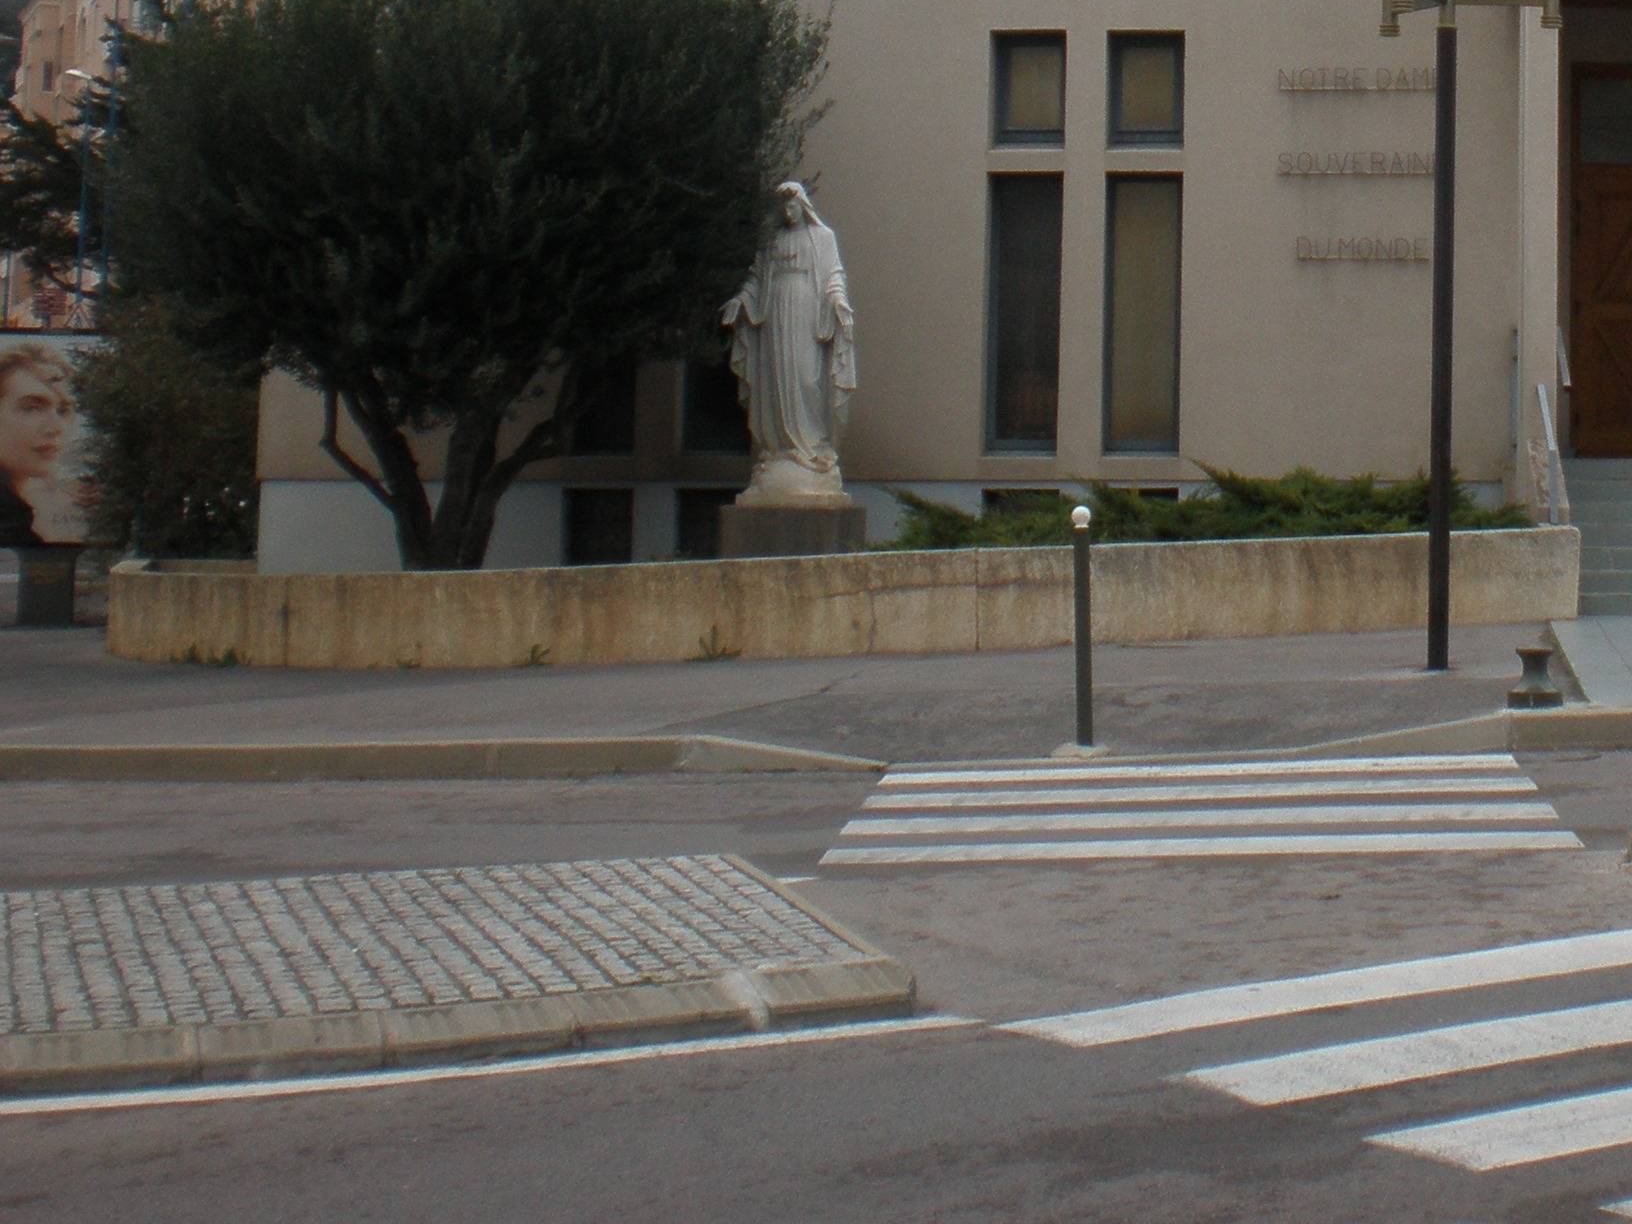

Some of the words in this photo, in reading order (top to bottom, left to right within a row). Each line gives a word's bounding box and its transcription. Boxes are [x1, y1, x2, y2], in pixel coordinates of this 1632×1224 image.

[1278, 68, 1367, 90] NOTRE
[1297, 237, 1330, 258] DU
[1338, 238, 1428, 259] MONDE
